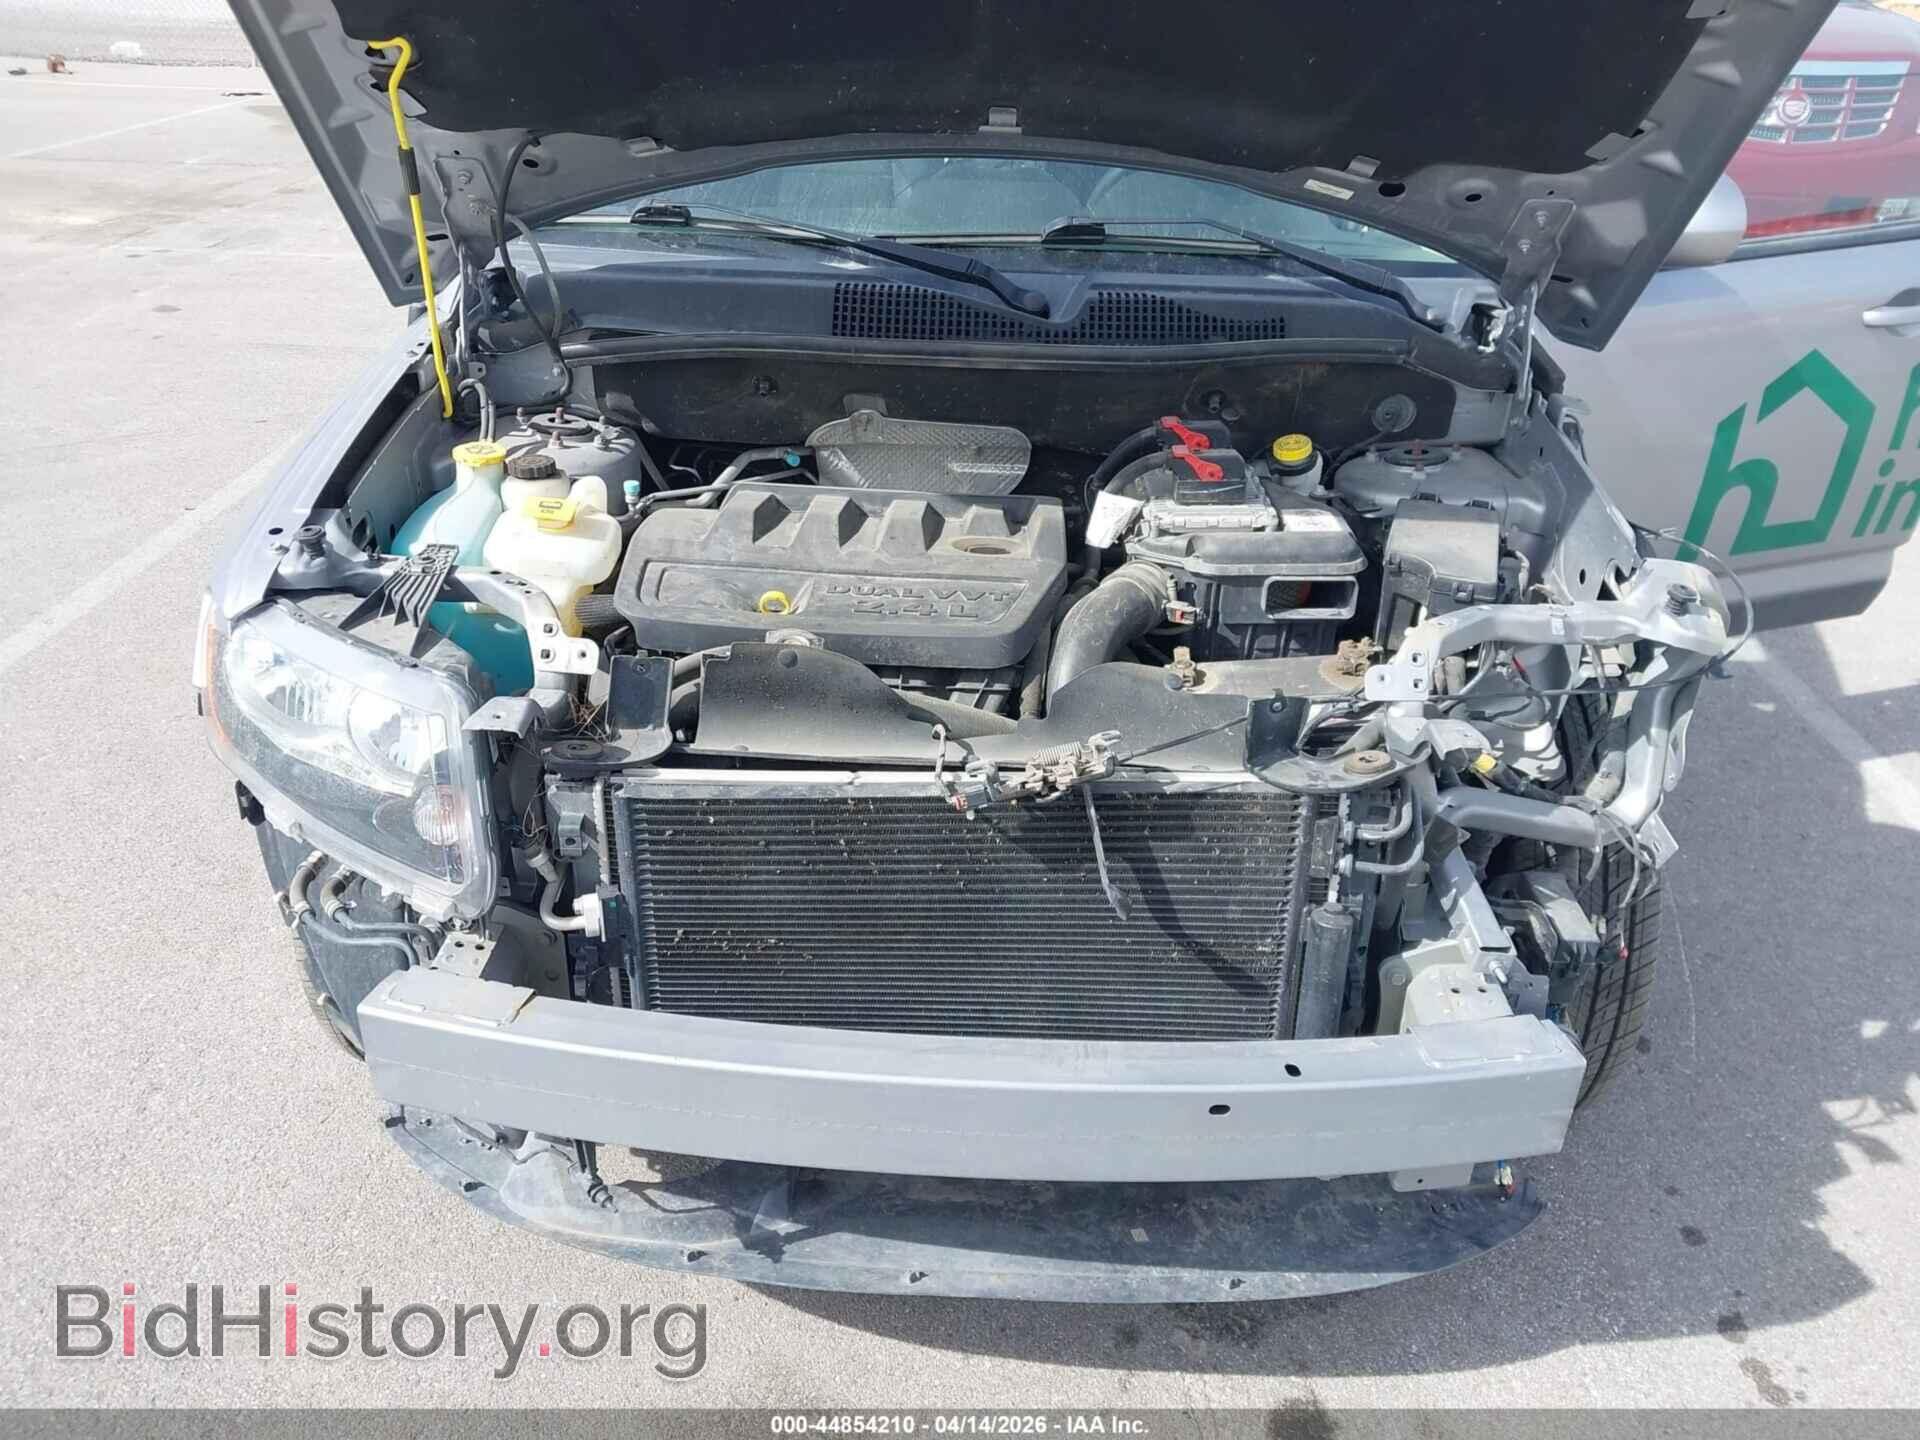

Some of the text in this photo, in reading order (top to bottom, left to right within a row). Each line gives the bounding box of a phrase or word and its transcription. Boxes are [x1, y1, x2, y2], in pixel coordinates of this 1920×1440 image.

[826, 581, 1010, 602] DUAL VVT
[852, 599, 979, 619] 2.4L
